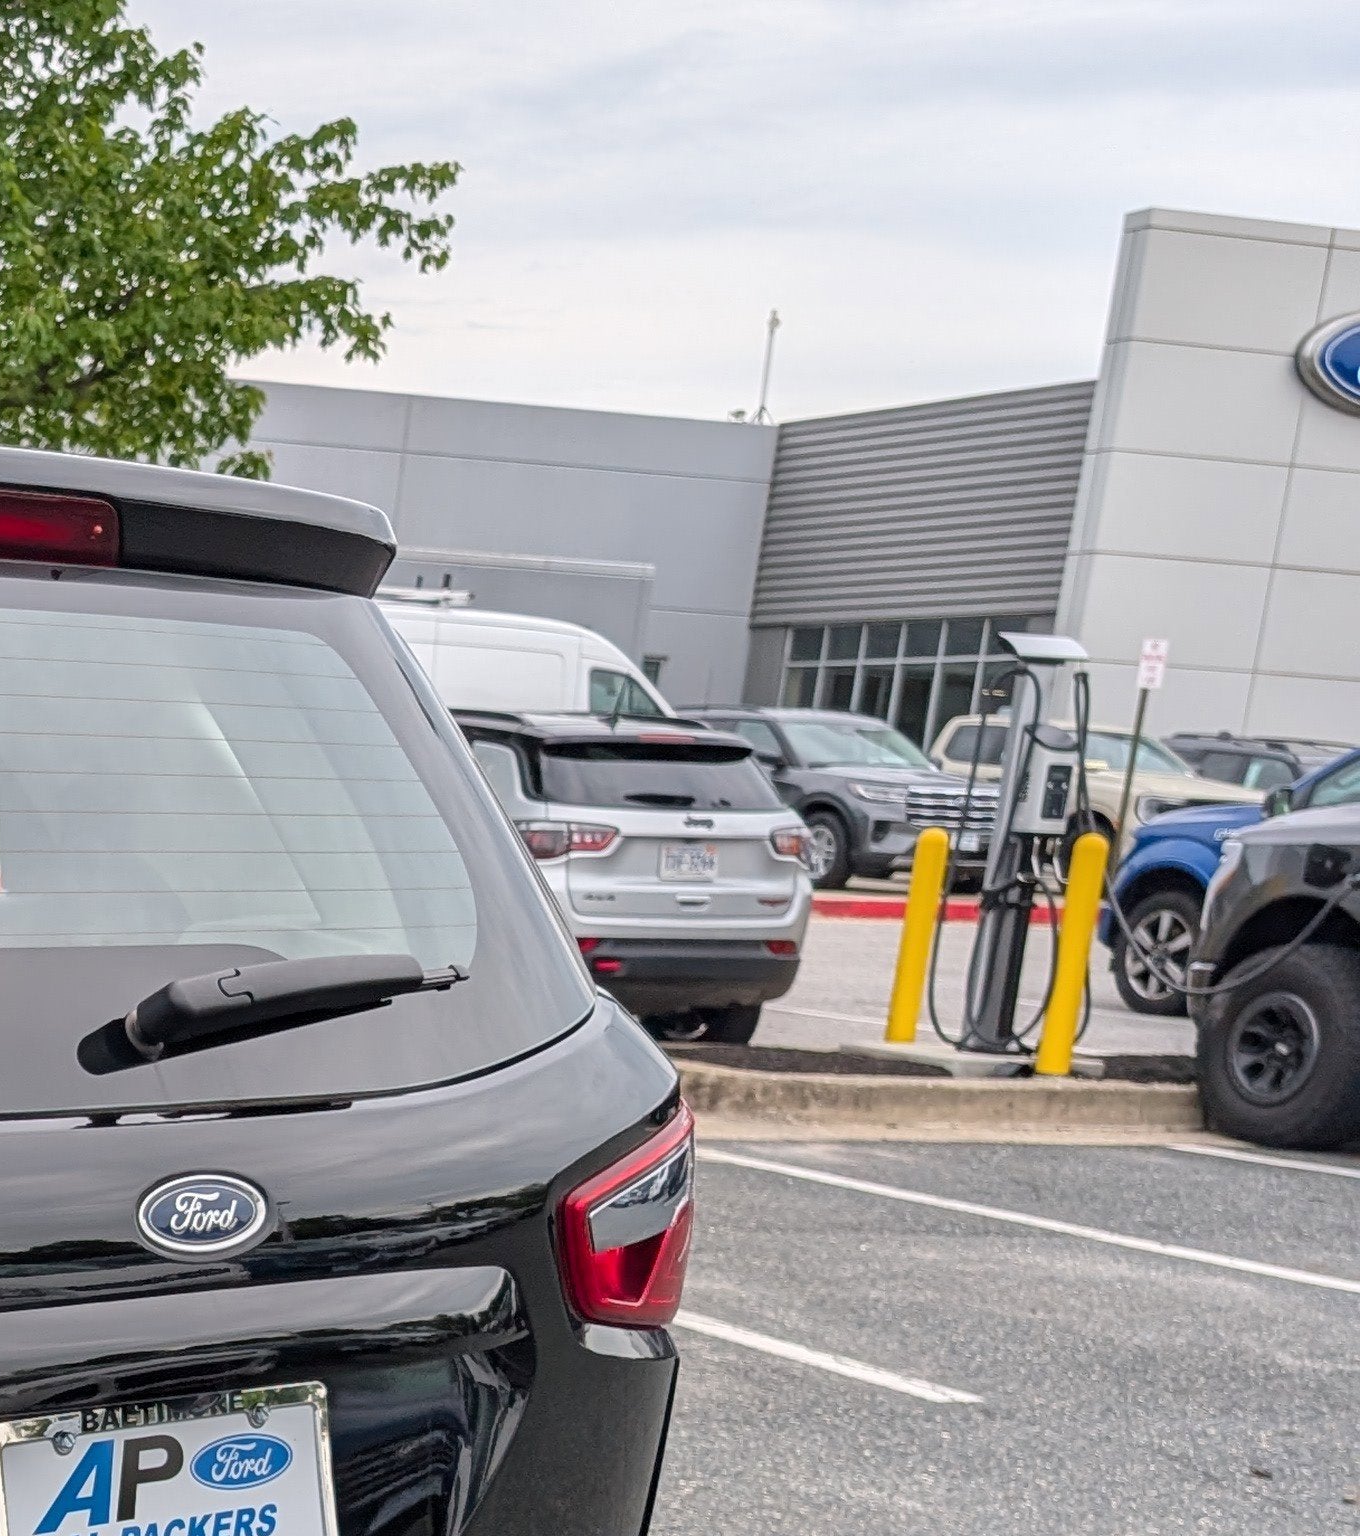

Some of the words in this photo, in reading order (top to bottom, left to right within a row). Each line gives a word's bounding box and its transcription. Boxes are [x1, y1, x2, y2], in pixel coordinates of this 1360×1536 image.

[170, 1191, 238, 1234] Ford
[211, 1444, 272, 1480] Ford
[33, 1435, 184, 1535] AP
